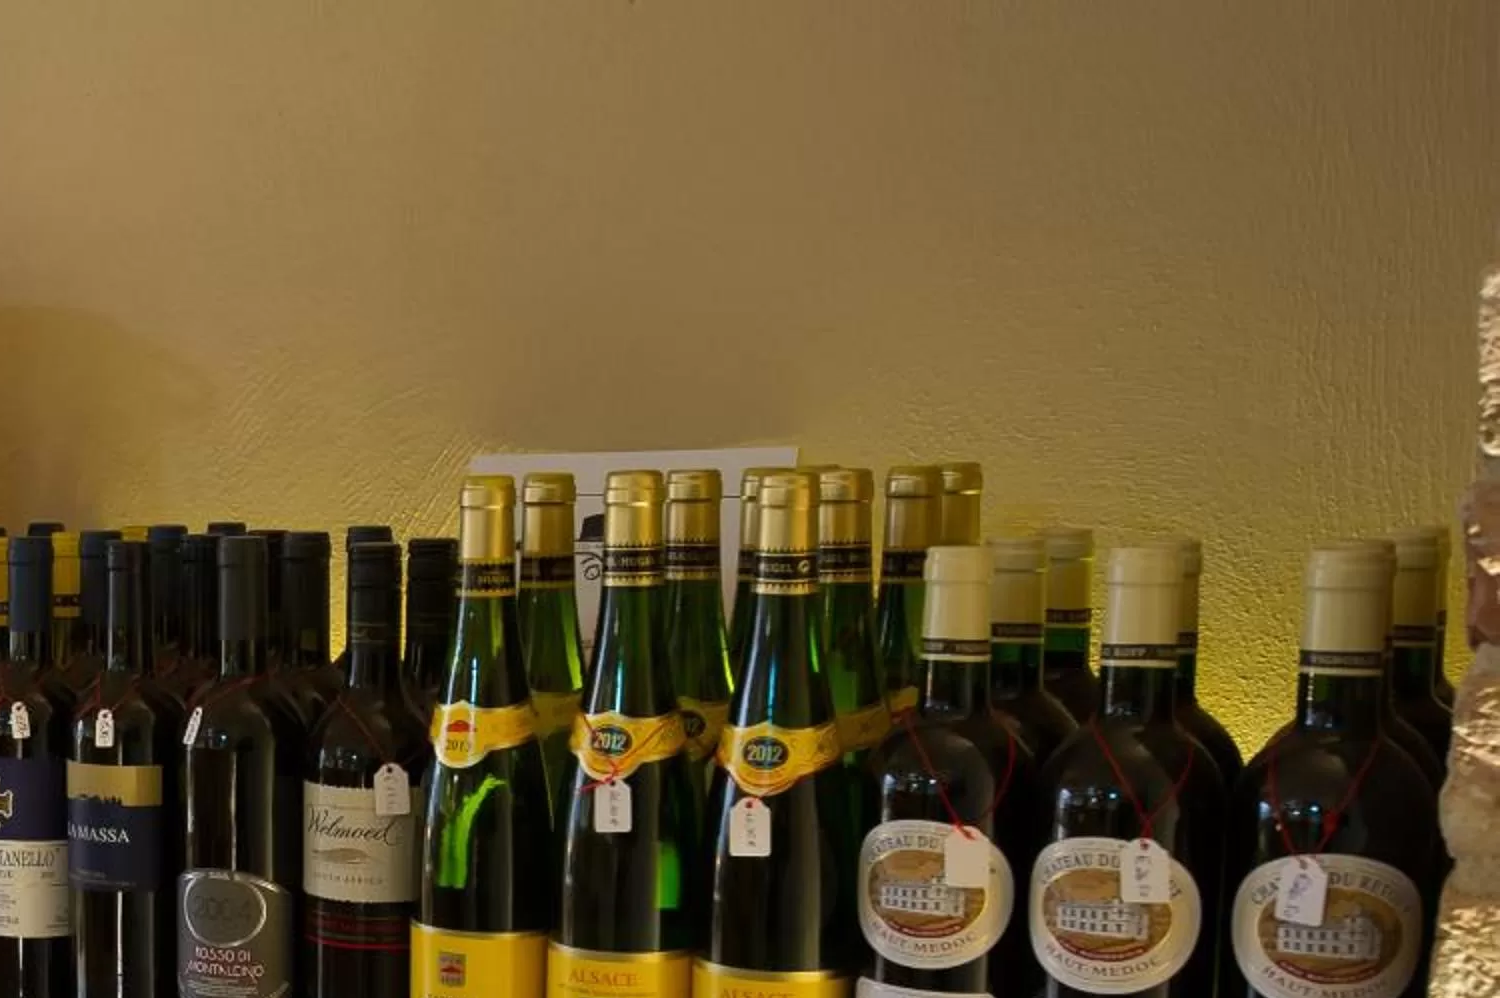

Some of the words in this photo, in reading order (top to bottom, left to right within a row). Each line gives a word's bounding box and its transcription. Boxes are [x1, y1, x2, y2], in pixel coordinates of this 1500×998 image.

[593, 731, 626, 751] 2012
[748, 745, 783, 761] 2012
[307, 806, 402, 846] Welmoed
[568, 969, 638, 987] ALSACE
